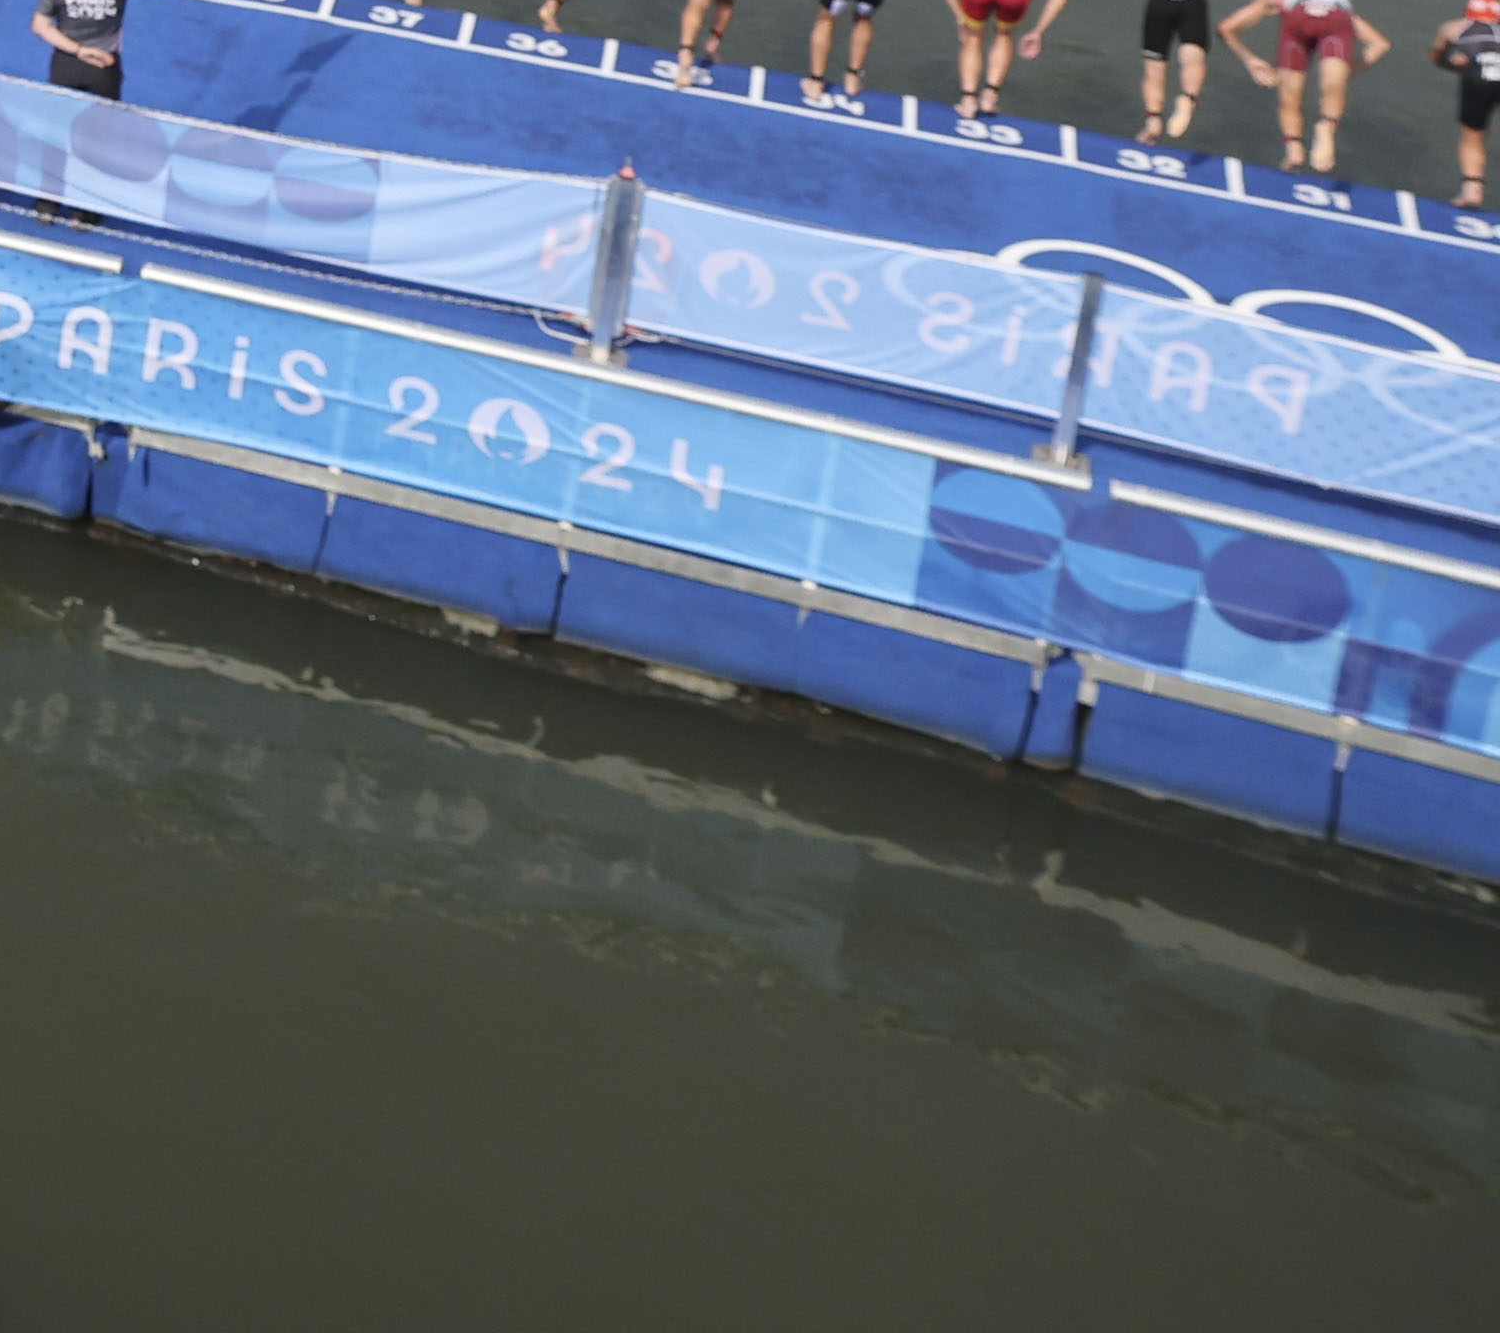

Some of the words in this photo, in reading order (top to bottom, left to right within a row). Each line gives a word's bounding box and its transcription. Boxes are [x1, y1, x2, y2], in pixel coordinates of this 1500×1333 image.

[368, 5, 425, 29] 37
[505, 32, 569, 58] 36
[954, 118, 1024, 146] 33
[1116, 148, 1188, 179] 32
[1291, 183, 1353, 212] 31
[385, 376, 725, 513] 2024
